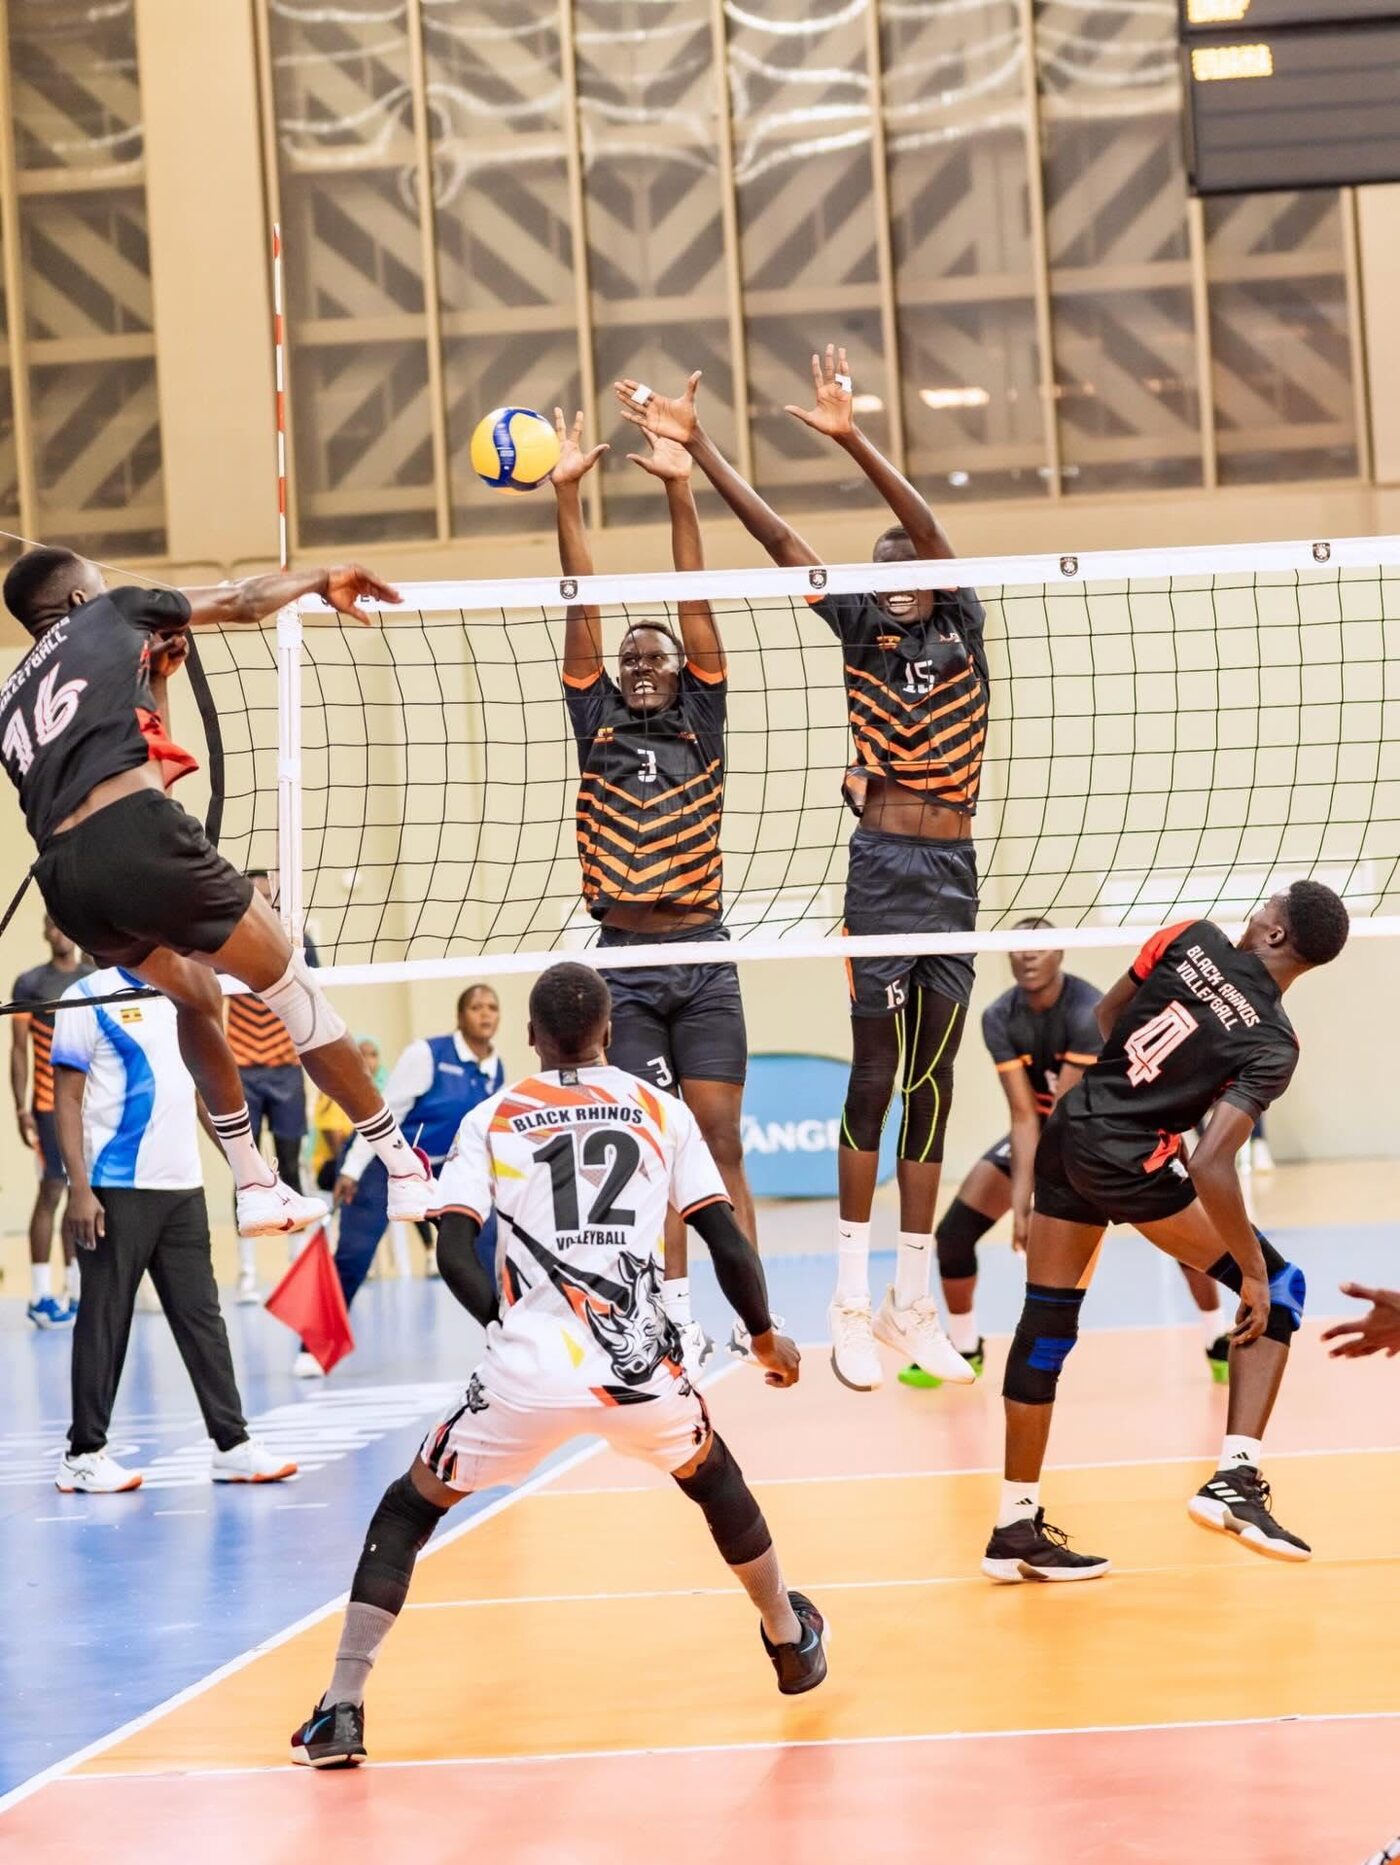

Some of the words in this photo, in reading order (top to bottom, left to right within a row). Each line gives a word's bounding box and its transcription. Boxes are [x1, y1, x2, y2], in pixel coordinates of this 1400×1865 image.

[903, 660, 935, 694] 15
[2, 661, 88, 776] 16
[637, 748, 657, 782] 3
[1186, 945, 1225, 986] BLACK
[885, 979, 905, 1009] 15
[1176, 960, 1238, 1031] VOLLEYBALL
[1124, 1000, 1199, 1088] 4
[646, 1056, 672, 1087] 3
[513, 1110, 571, 1133] BLACK
[576, 1106, 643, 1124] RHINOS
[533, 1129, 640, 1232] 12
